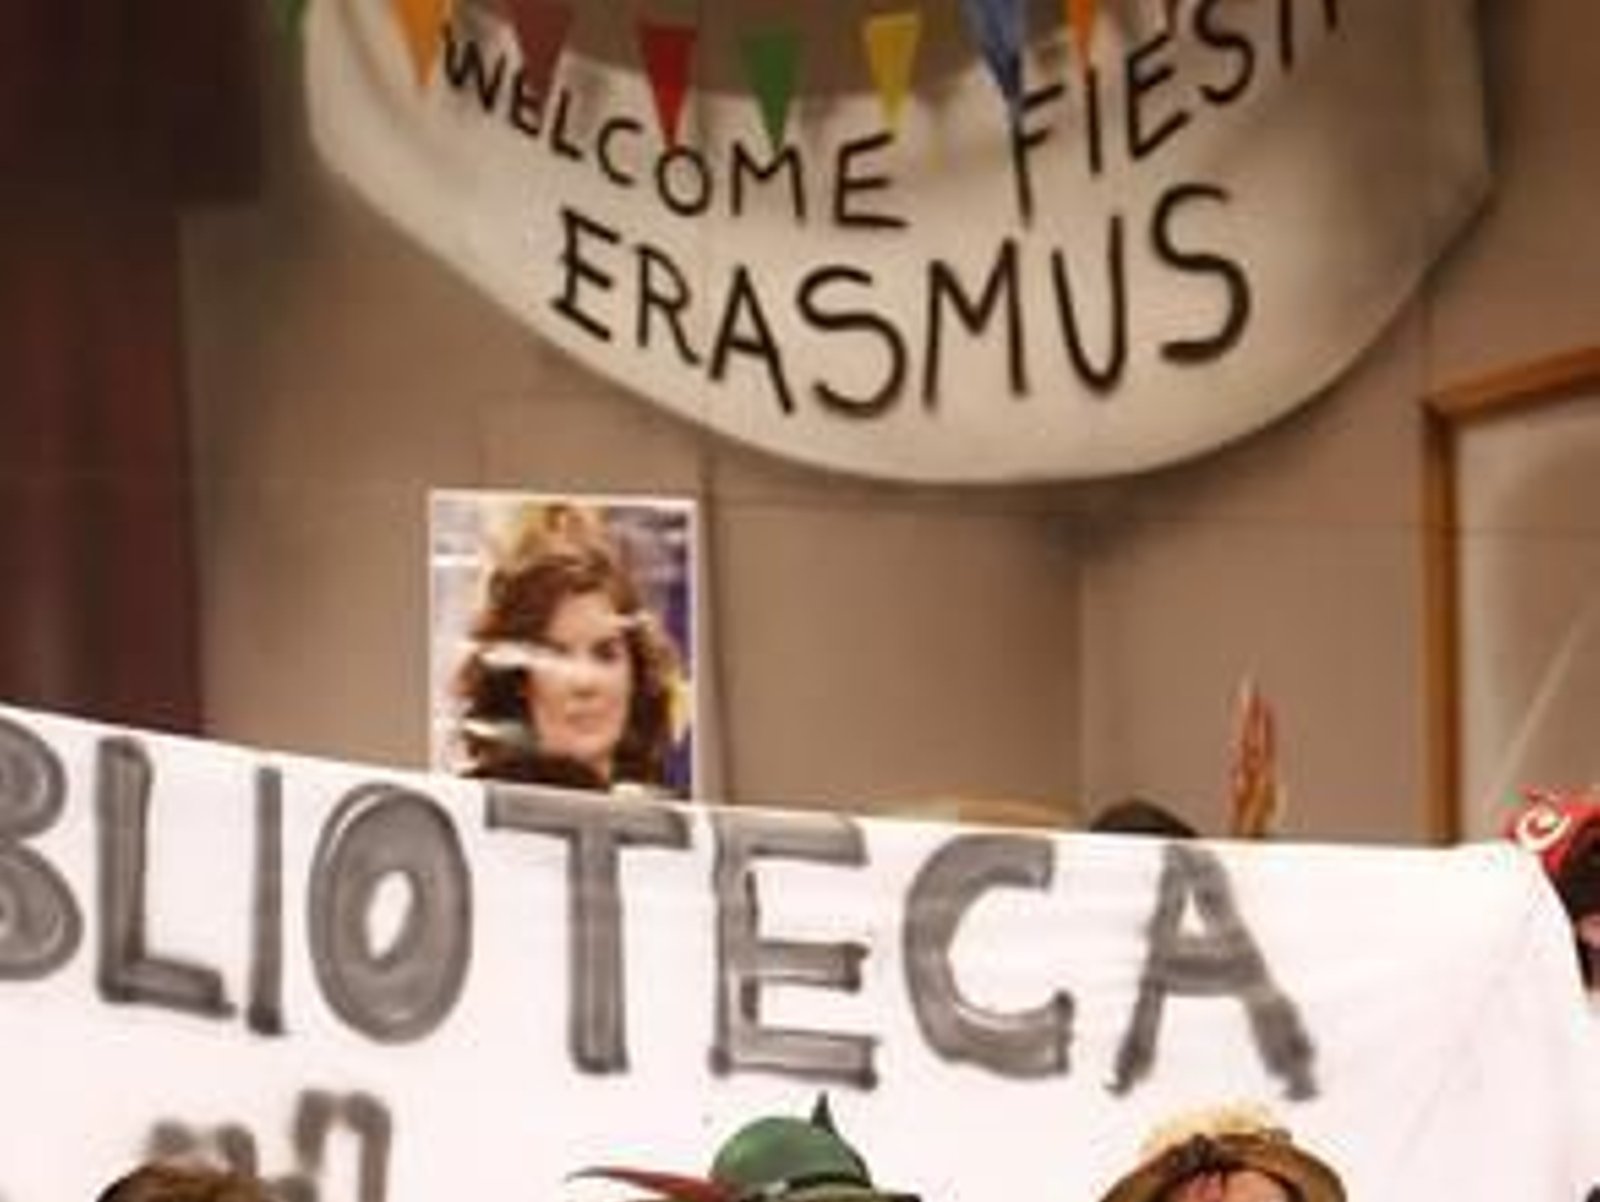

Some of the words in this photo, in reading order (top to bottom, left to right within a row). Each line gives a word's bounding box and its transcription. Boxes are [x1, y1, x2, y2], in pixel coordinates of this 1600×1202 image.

[443, 19, 909, 228] WELCOME
[1006, 0, 1340, 232] FIES
[550, 182, 1252, 418] ERASMUS
